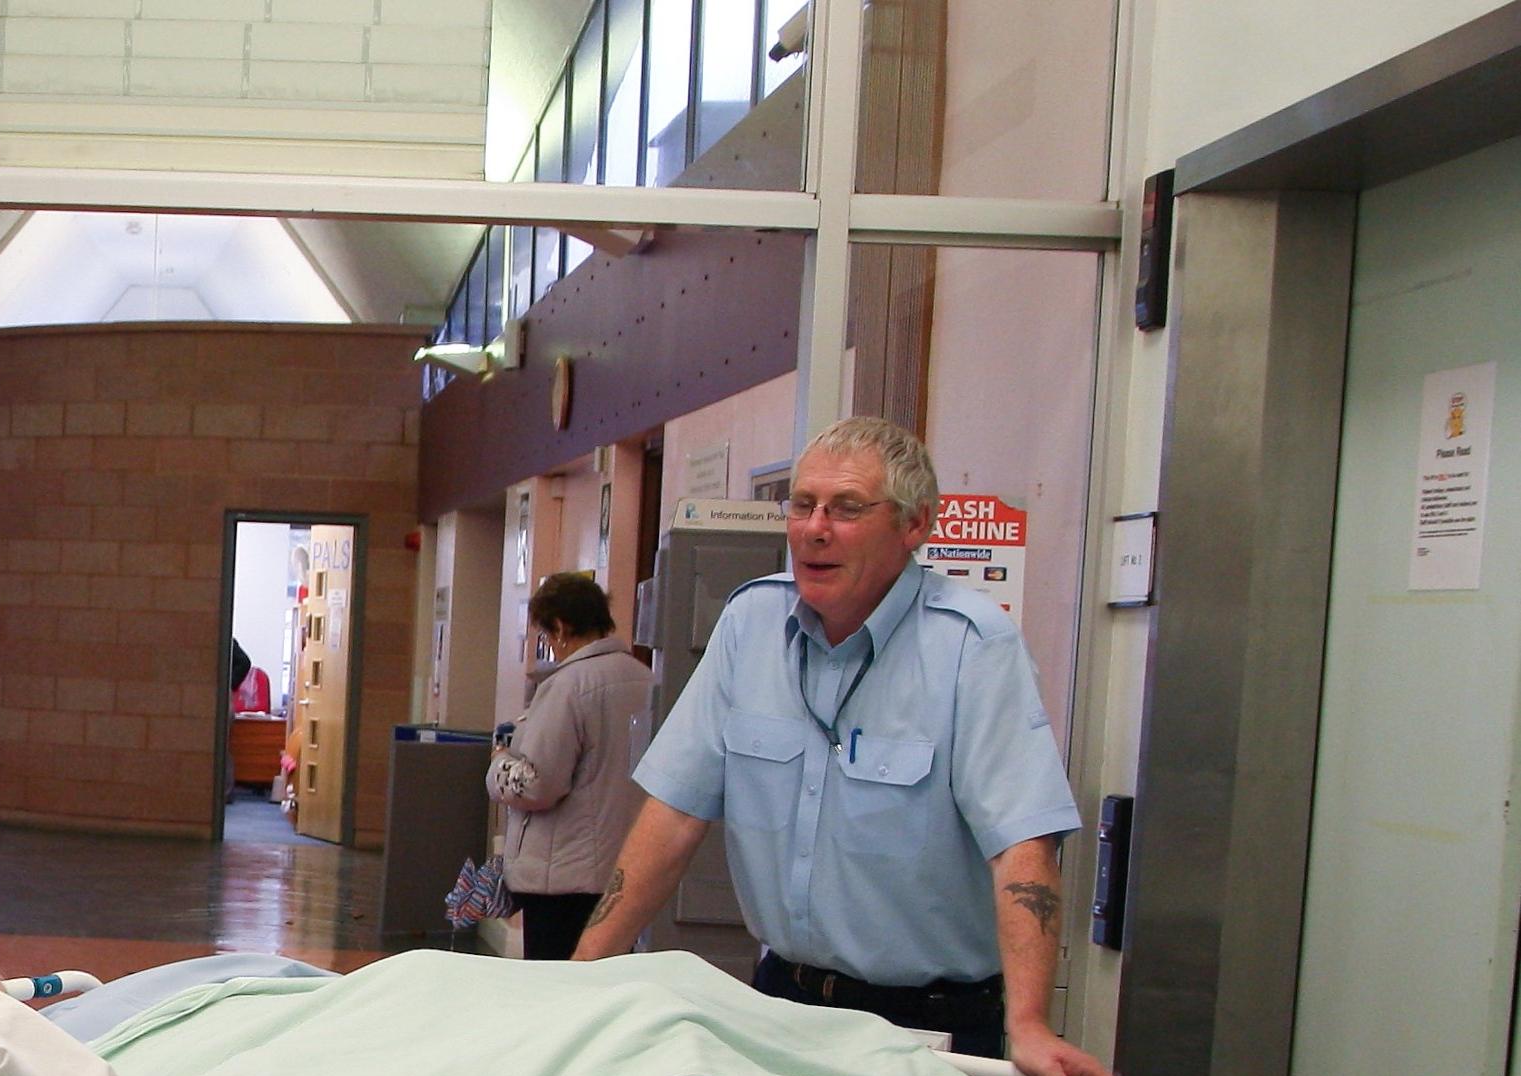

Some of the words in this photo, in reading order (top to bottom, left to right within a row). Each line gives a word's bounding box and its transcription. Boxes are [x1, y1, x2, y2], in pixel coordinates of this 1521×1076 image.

[710, 510, 764, 521] Information
[767, 513, 789, 522] Poin
[937, 499, 995, 519] ASH
[931, 520, 1020, 541] ACHINE
[313, 540, 350, 569] PALS
[939, 549, 991, 560] Nationwide
